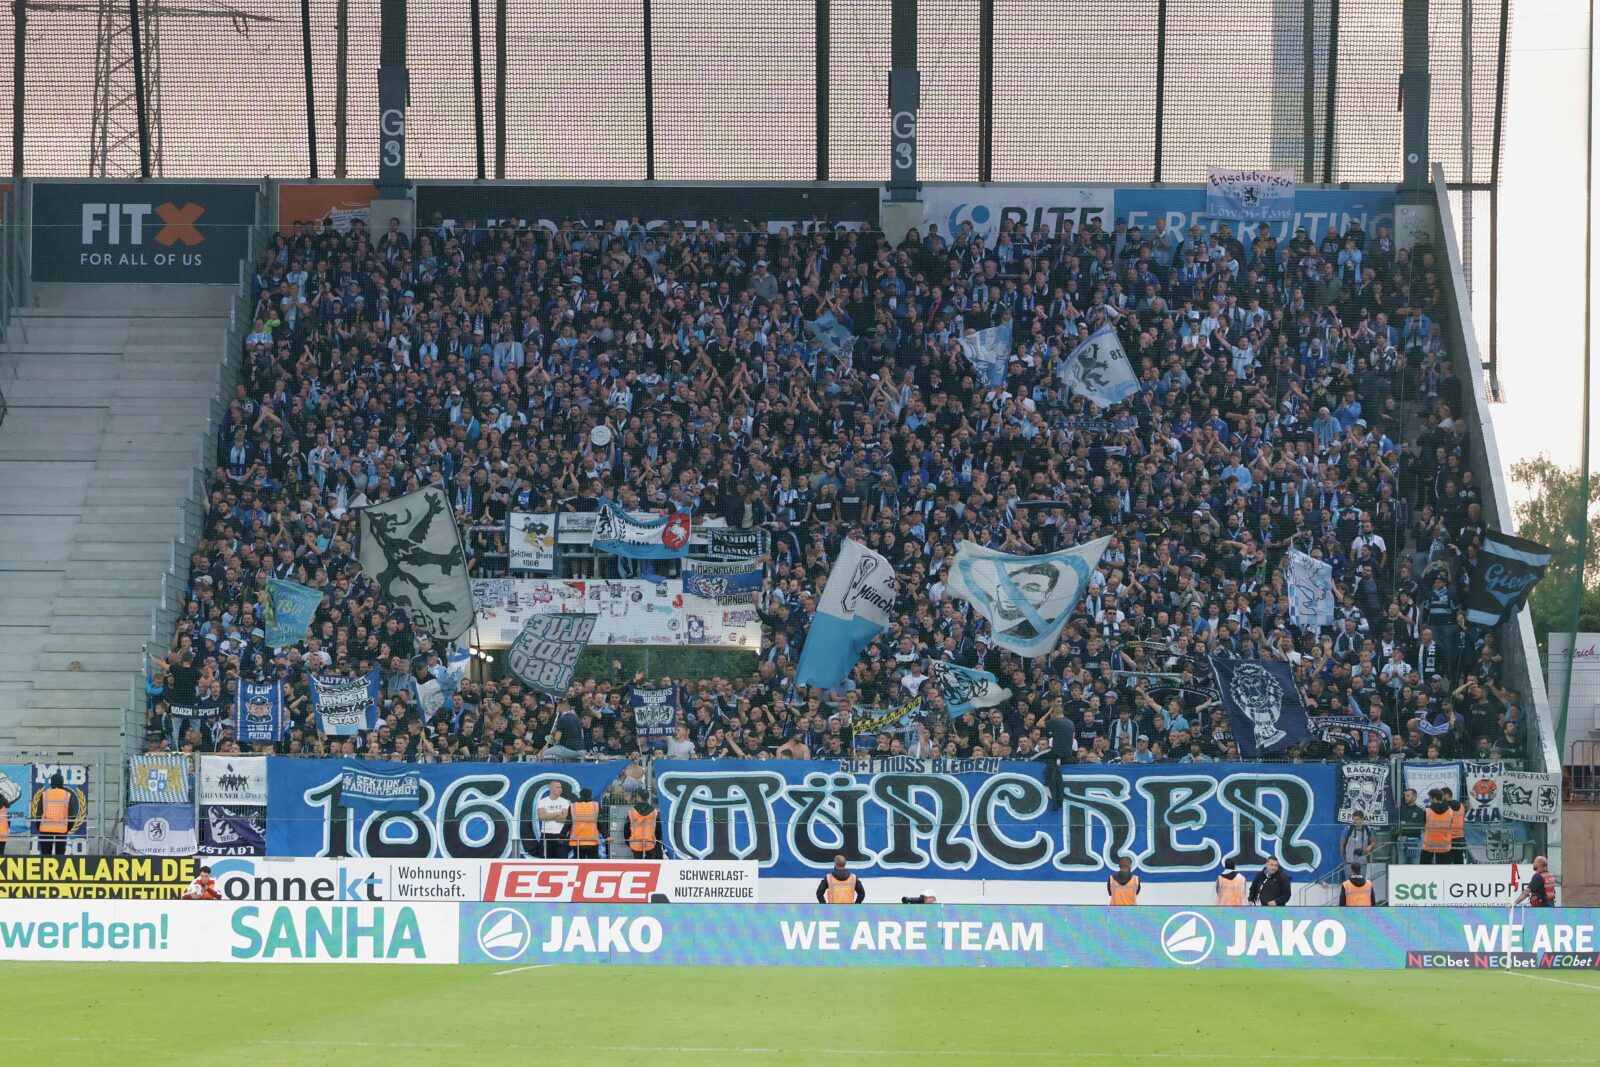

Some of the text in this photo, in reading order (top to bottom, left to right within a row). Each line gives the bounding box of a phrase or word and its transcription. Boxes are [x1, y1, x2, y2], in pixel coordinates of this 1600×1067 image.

[380, 109, 404, 137] G
[892, 111, 916, 139] G
[383, 140, 402, 168] 3
[895, 142, 913, 170] 3
[80, 253, 202, 266] FOR ALL OF US
[717, 593, 756, 606] PORNBAC
[255, 685, 272, 694] COP
[198, 707, 219, 716] SPORT
[248, 731, 272, 739] FRIEND
[880, 757, 925, 774] MUSS
[931, 756, 999, 774] BLEIBEN!
[356, 775, 400, 785] SEKTION
[1341, 812, 1385, 822] SPANTE
[398, 866, 467, 882] Wohnungs-
[679, 870, 749, 882] SCHWERLAST-
[398, 884, 466, 897] Wirtschaft.
[505, 870, 651, 899] ES-GE
[674, 886, 754, 898] NUTZFAHRZEUGE
[1394, 881, 1437, 900] sat
[0, 912, 168, 949] werben!
[231, 906, 427, 959] SANHA
[542, 916, 662, 953] JAKO
[781, 921, 1044, 951] WE ARE TEAM
[1226, 919, 1347, 956] JAKO
[1463, 924, 1594, 952] WE ARE
